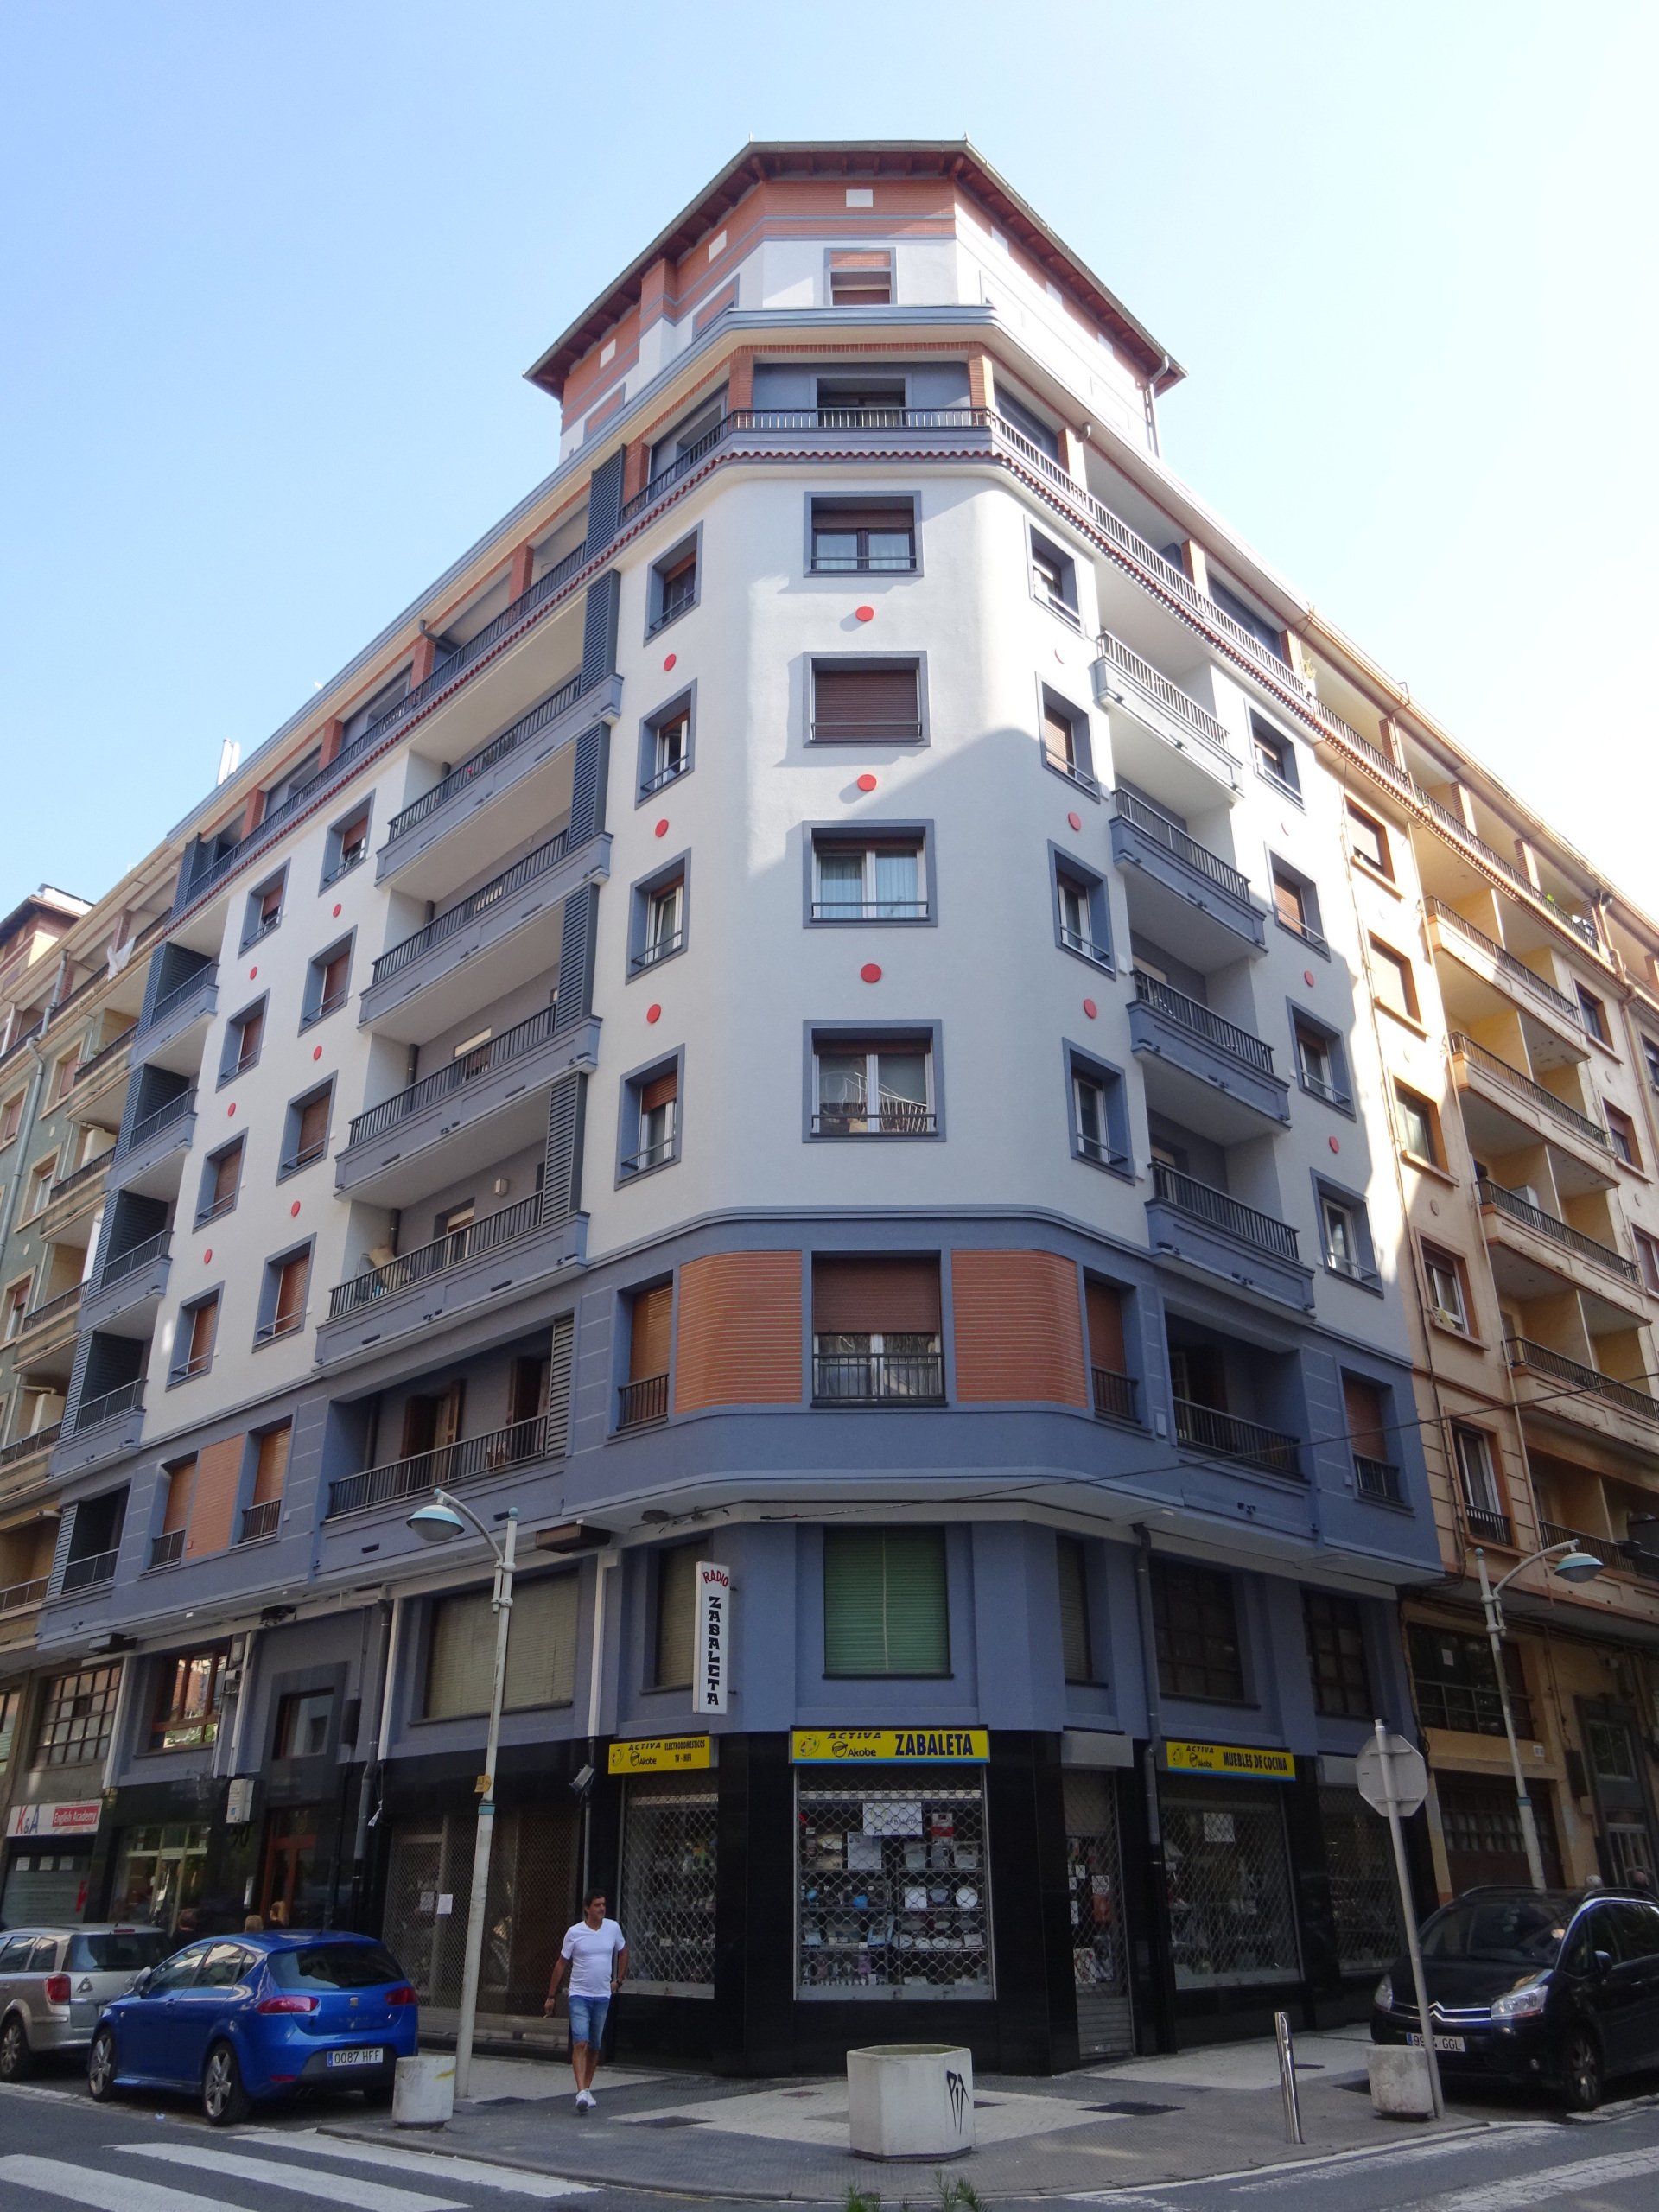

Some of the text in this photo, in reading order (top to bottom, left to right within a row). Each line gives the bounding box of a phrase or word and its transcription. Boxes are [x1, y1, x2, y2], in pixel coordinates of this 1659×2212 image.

[702, 1569, 729, 1588] RADIO
[707, 1596, 721, 1706] ZABALETA
[628, 1742, 661, 1751] ACTIVA
[848, 1748, 876, 1757] Akobe
[894, 1733, 974, 1756] ZABALETA
[1185, 1745, 1215, 1754] ACTIVA
[1223, 1751, 1288, 1771] MUEBLES DE COCINA
[54, 1808, 97, 1826] English Academy
[1441, 2037, 1461, 2050] GGL
[334, 2050, 379, 2064] 0087 HFF
